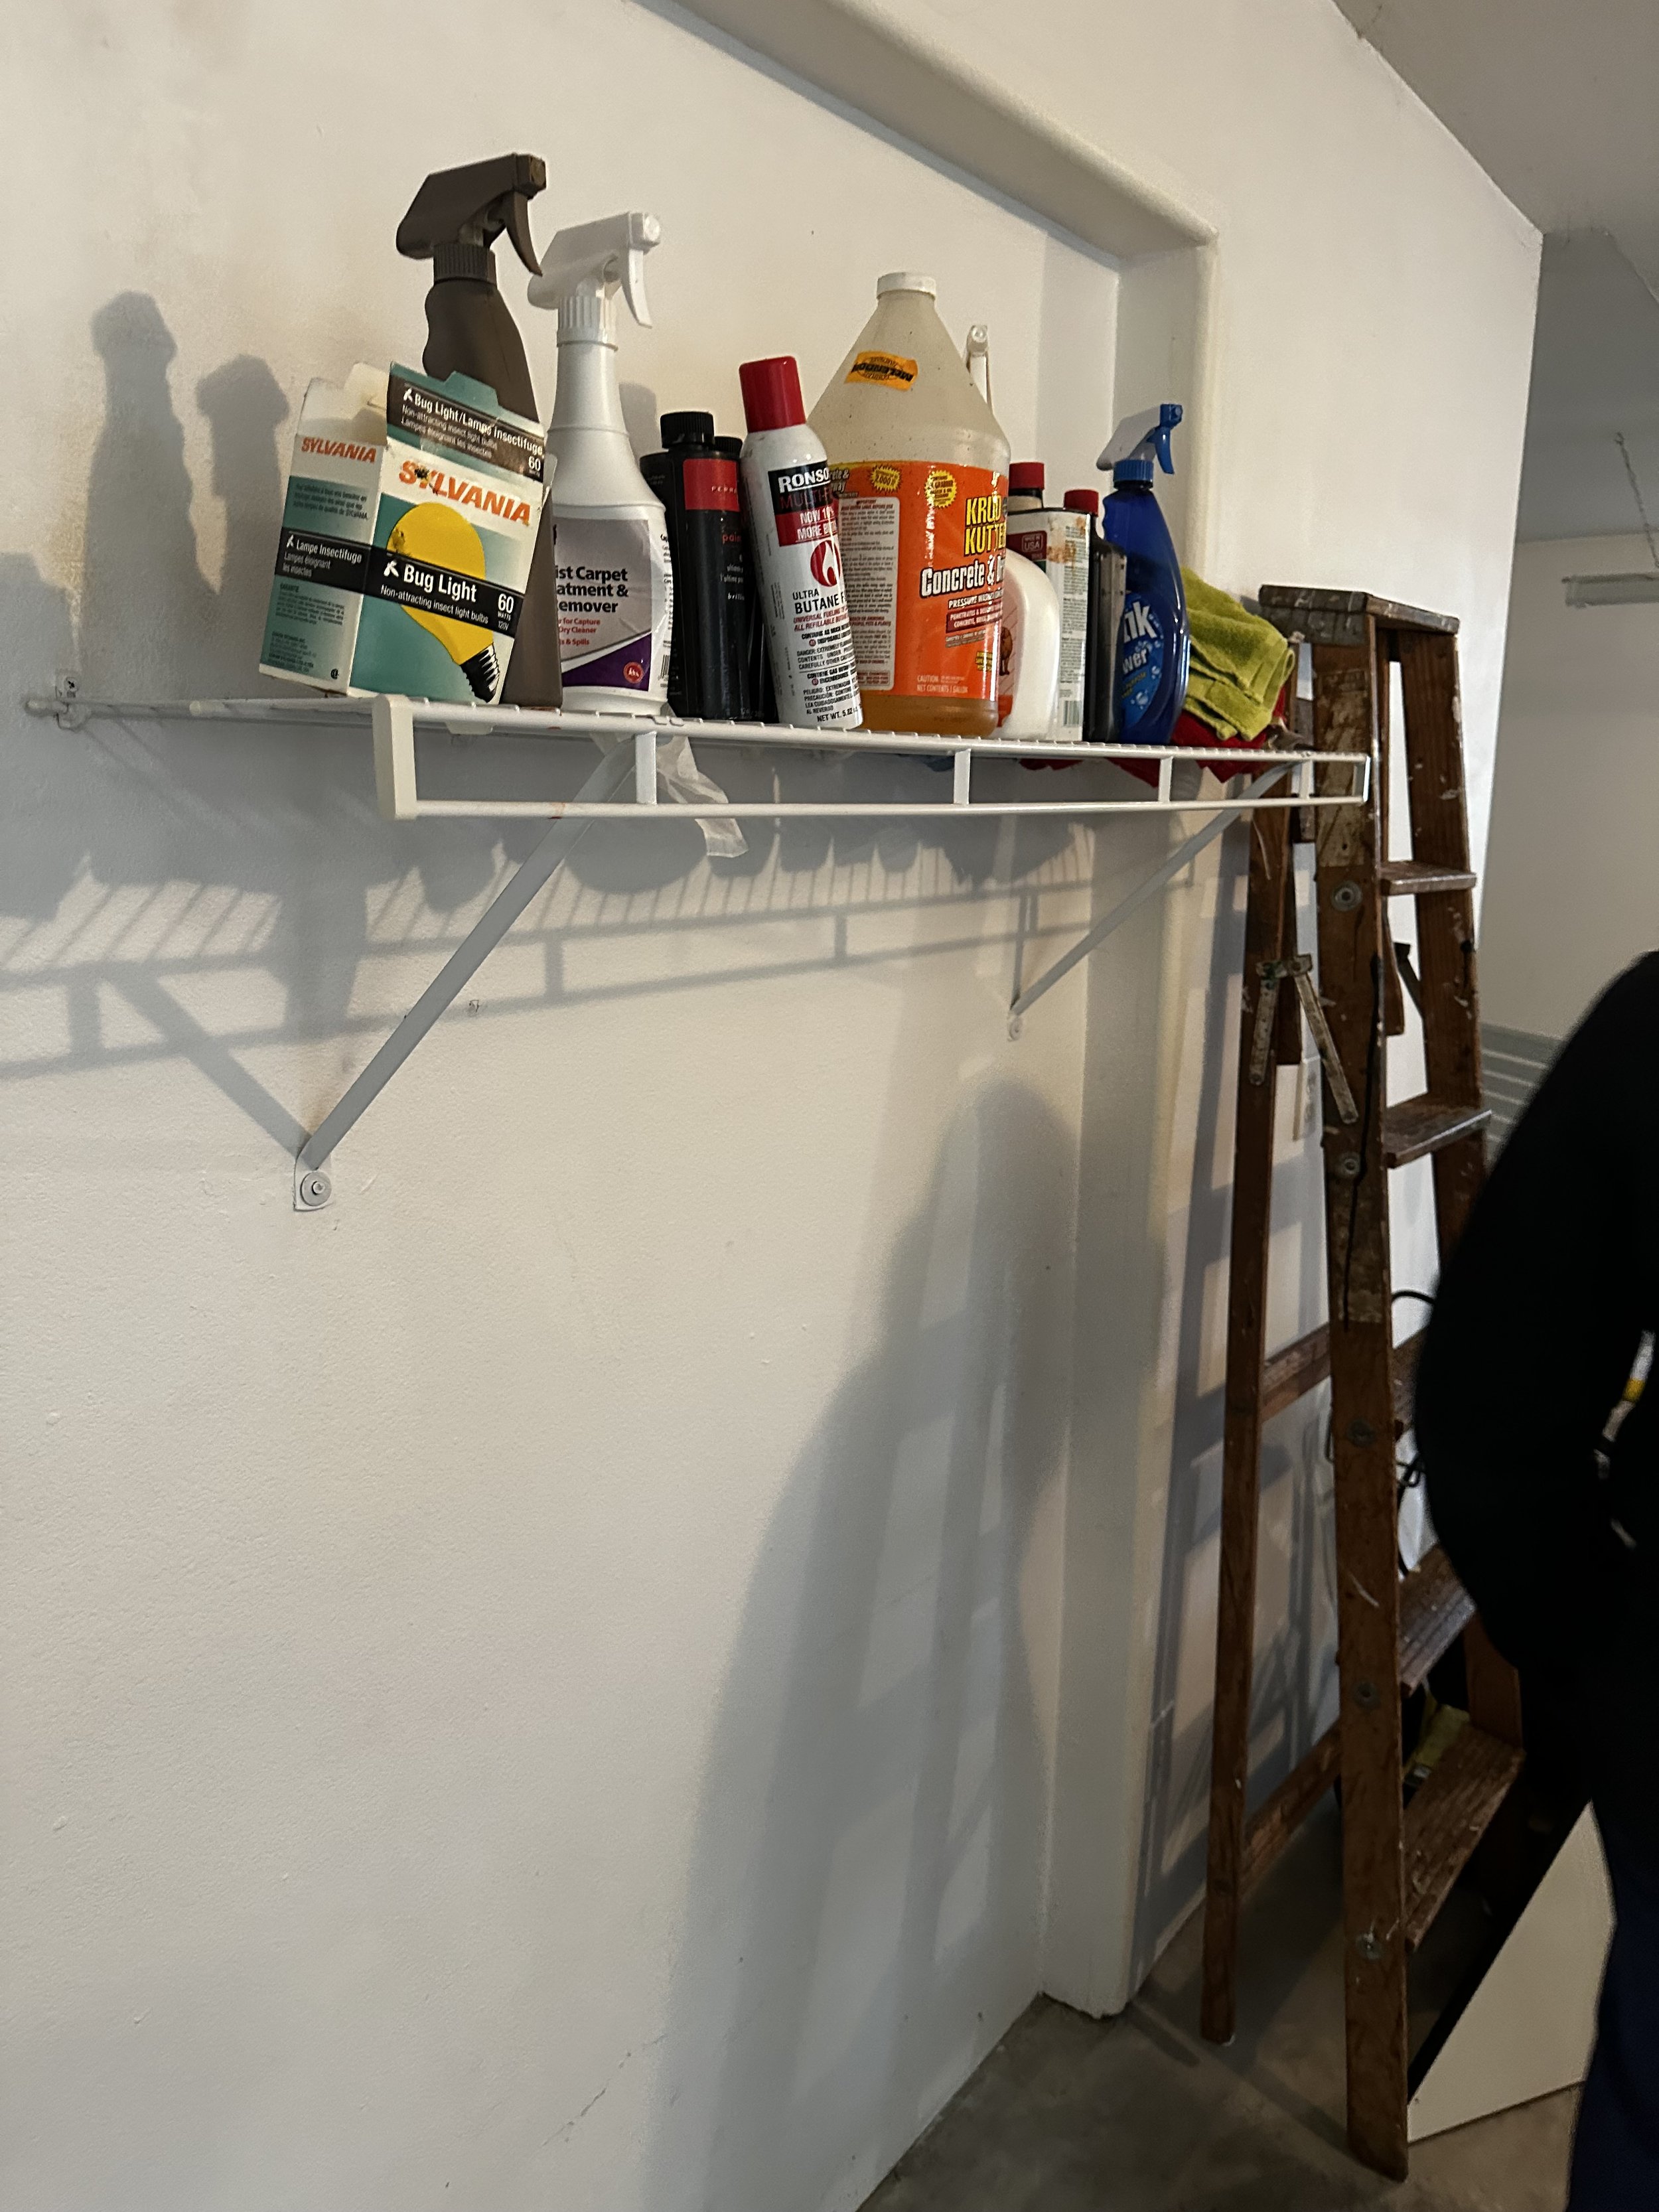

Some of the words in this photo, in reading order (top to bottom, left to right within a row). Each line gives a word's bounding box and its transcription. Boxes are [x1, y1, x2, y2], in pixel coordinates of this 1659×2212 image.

[415, 393, 433, 413] Bug
[301, 436, 377, 463] SYLVANIA
[528, 456, 541, 472] 60
[778, 467, 830, 494] RONSO
[399, 461, 531, 526] SYLVANIA
[800, 510, 820, 524] NOW
[966, 494, 1001, 526] KRUD
[797, 524, 822, 540] MORE
[296, 539, 317, 554] Lampe
[319, 545, 362, 564] Insectifuge
[1024, 540, 1040, 551] USA
[404, 563, 433, 593] Bug
[438, 573, 477, 603] Light
[555, 565, 573, 579] ist
[576, 566, 628, 584] Carpet
[921, 559, 985, 597] Concrete
[557, 582, 613, 597] atment
[616, 584, 629, 597] &
[792, 588, 819, 600] ULTRA
[381, 584, 432, 609] Non-attracting
[433, 600, 454, 615] insect
[455, 605, 470, 619] light
[471, 609, 489, 625] bulbs
[498, 593, 514, 614] 60
[559, 600, 618, 613] emover
[795, 593, 839, 615] BUTANE
[573, 618, 601, 627] Capture
[794, 624, 804, 632] ALL
[572, 638, 590, 646] Spills
[1122, 648, 1147, 675] wer
[830, 711, 842, 720] WT.
